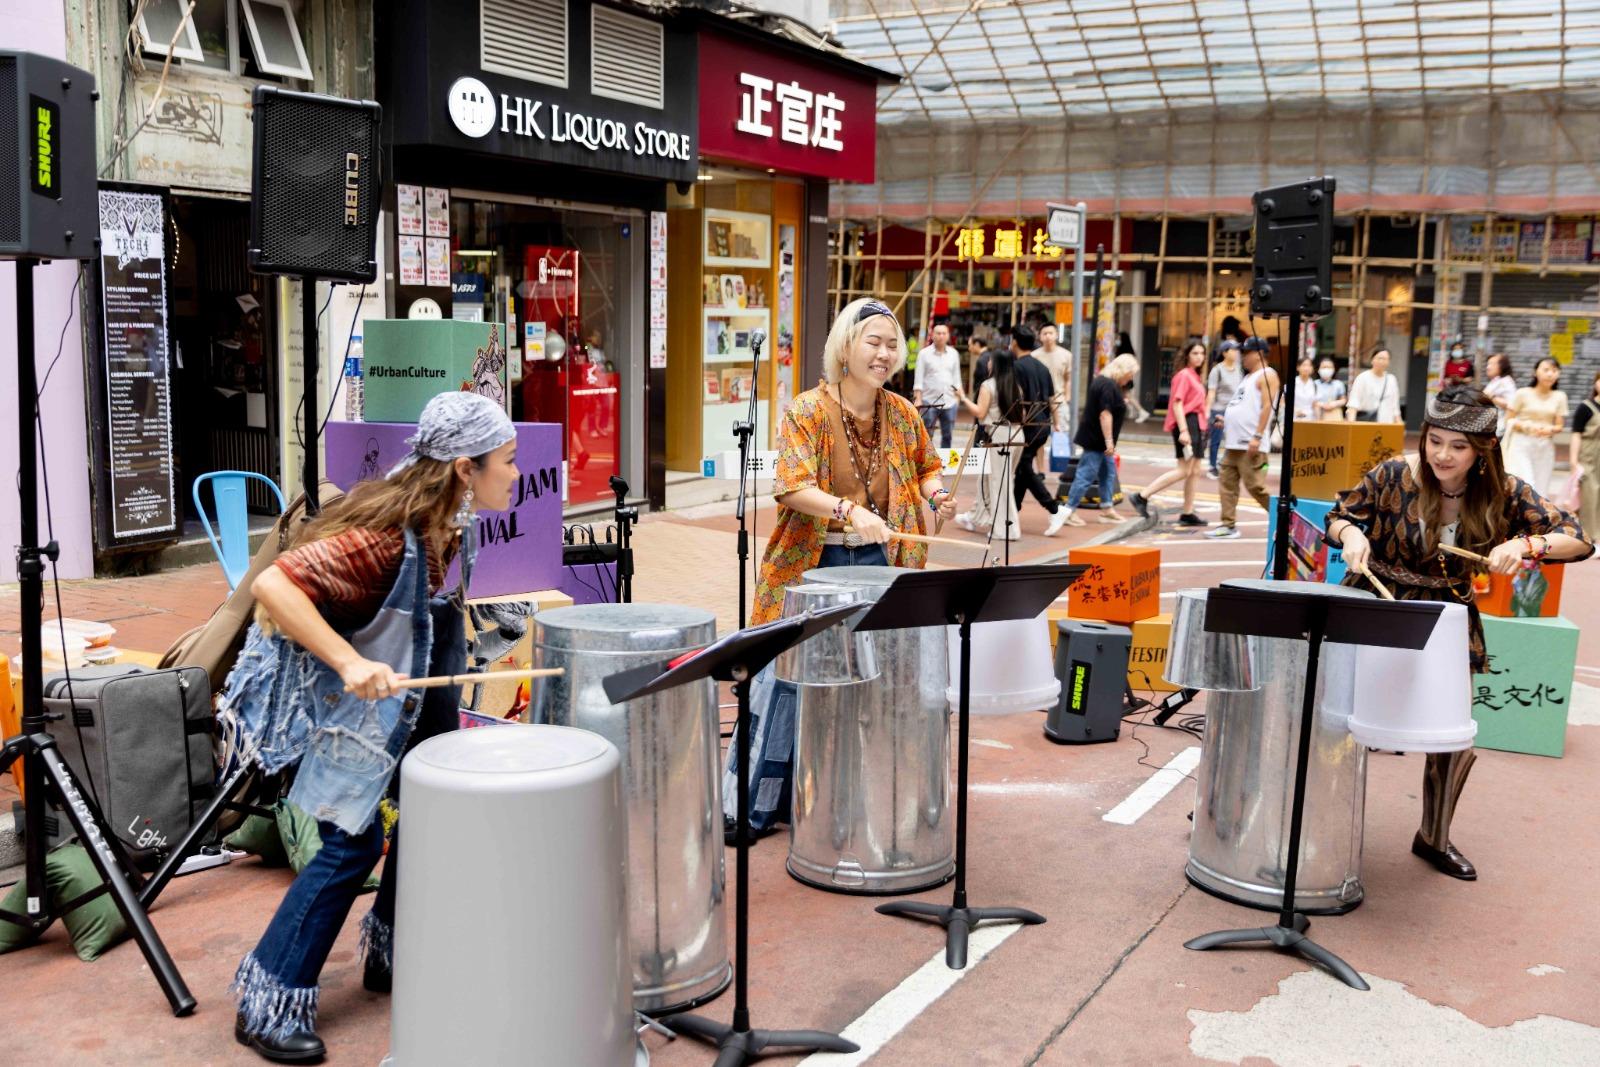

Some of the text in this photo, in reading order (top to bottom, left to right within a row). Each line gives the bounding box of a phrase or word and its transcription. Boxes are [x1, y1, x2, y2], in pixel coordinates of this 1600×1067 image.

[500, 93, 546, 140] HK
[737, 72, 845, 151] 正官庄
[38, 106, 52, 188] SHURE
[344, 152, 359, 226] CUBE
[369, 366, 446, 378] #UrbanCulture
[1325, 446, 1344, 461] JAM
[514, 467, 558, 507] JAM
[1072, 665, 1086, 710] SHURE
[1473, 683, 1564, 711] 是文化
